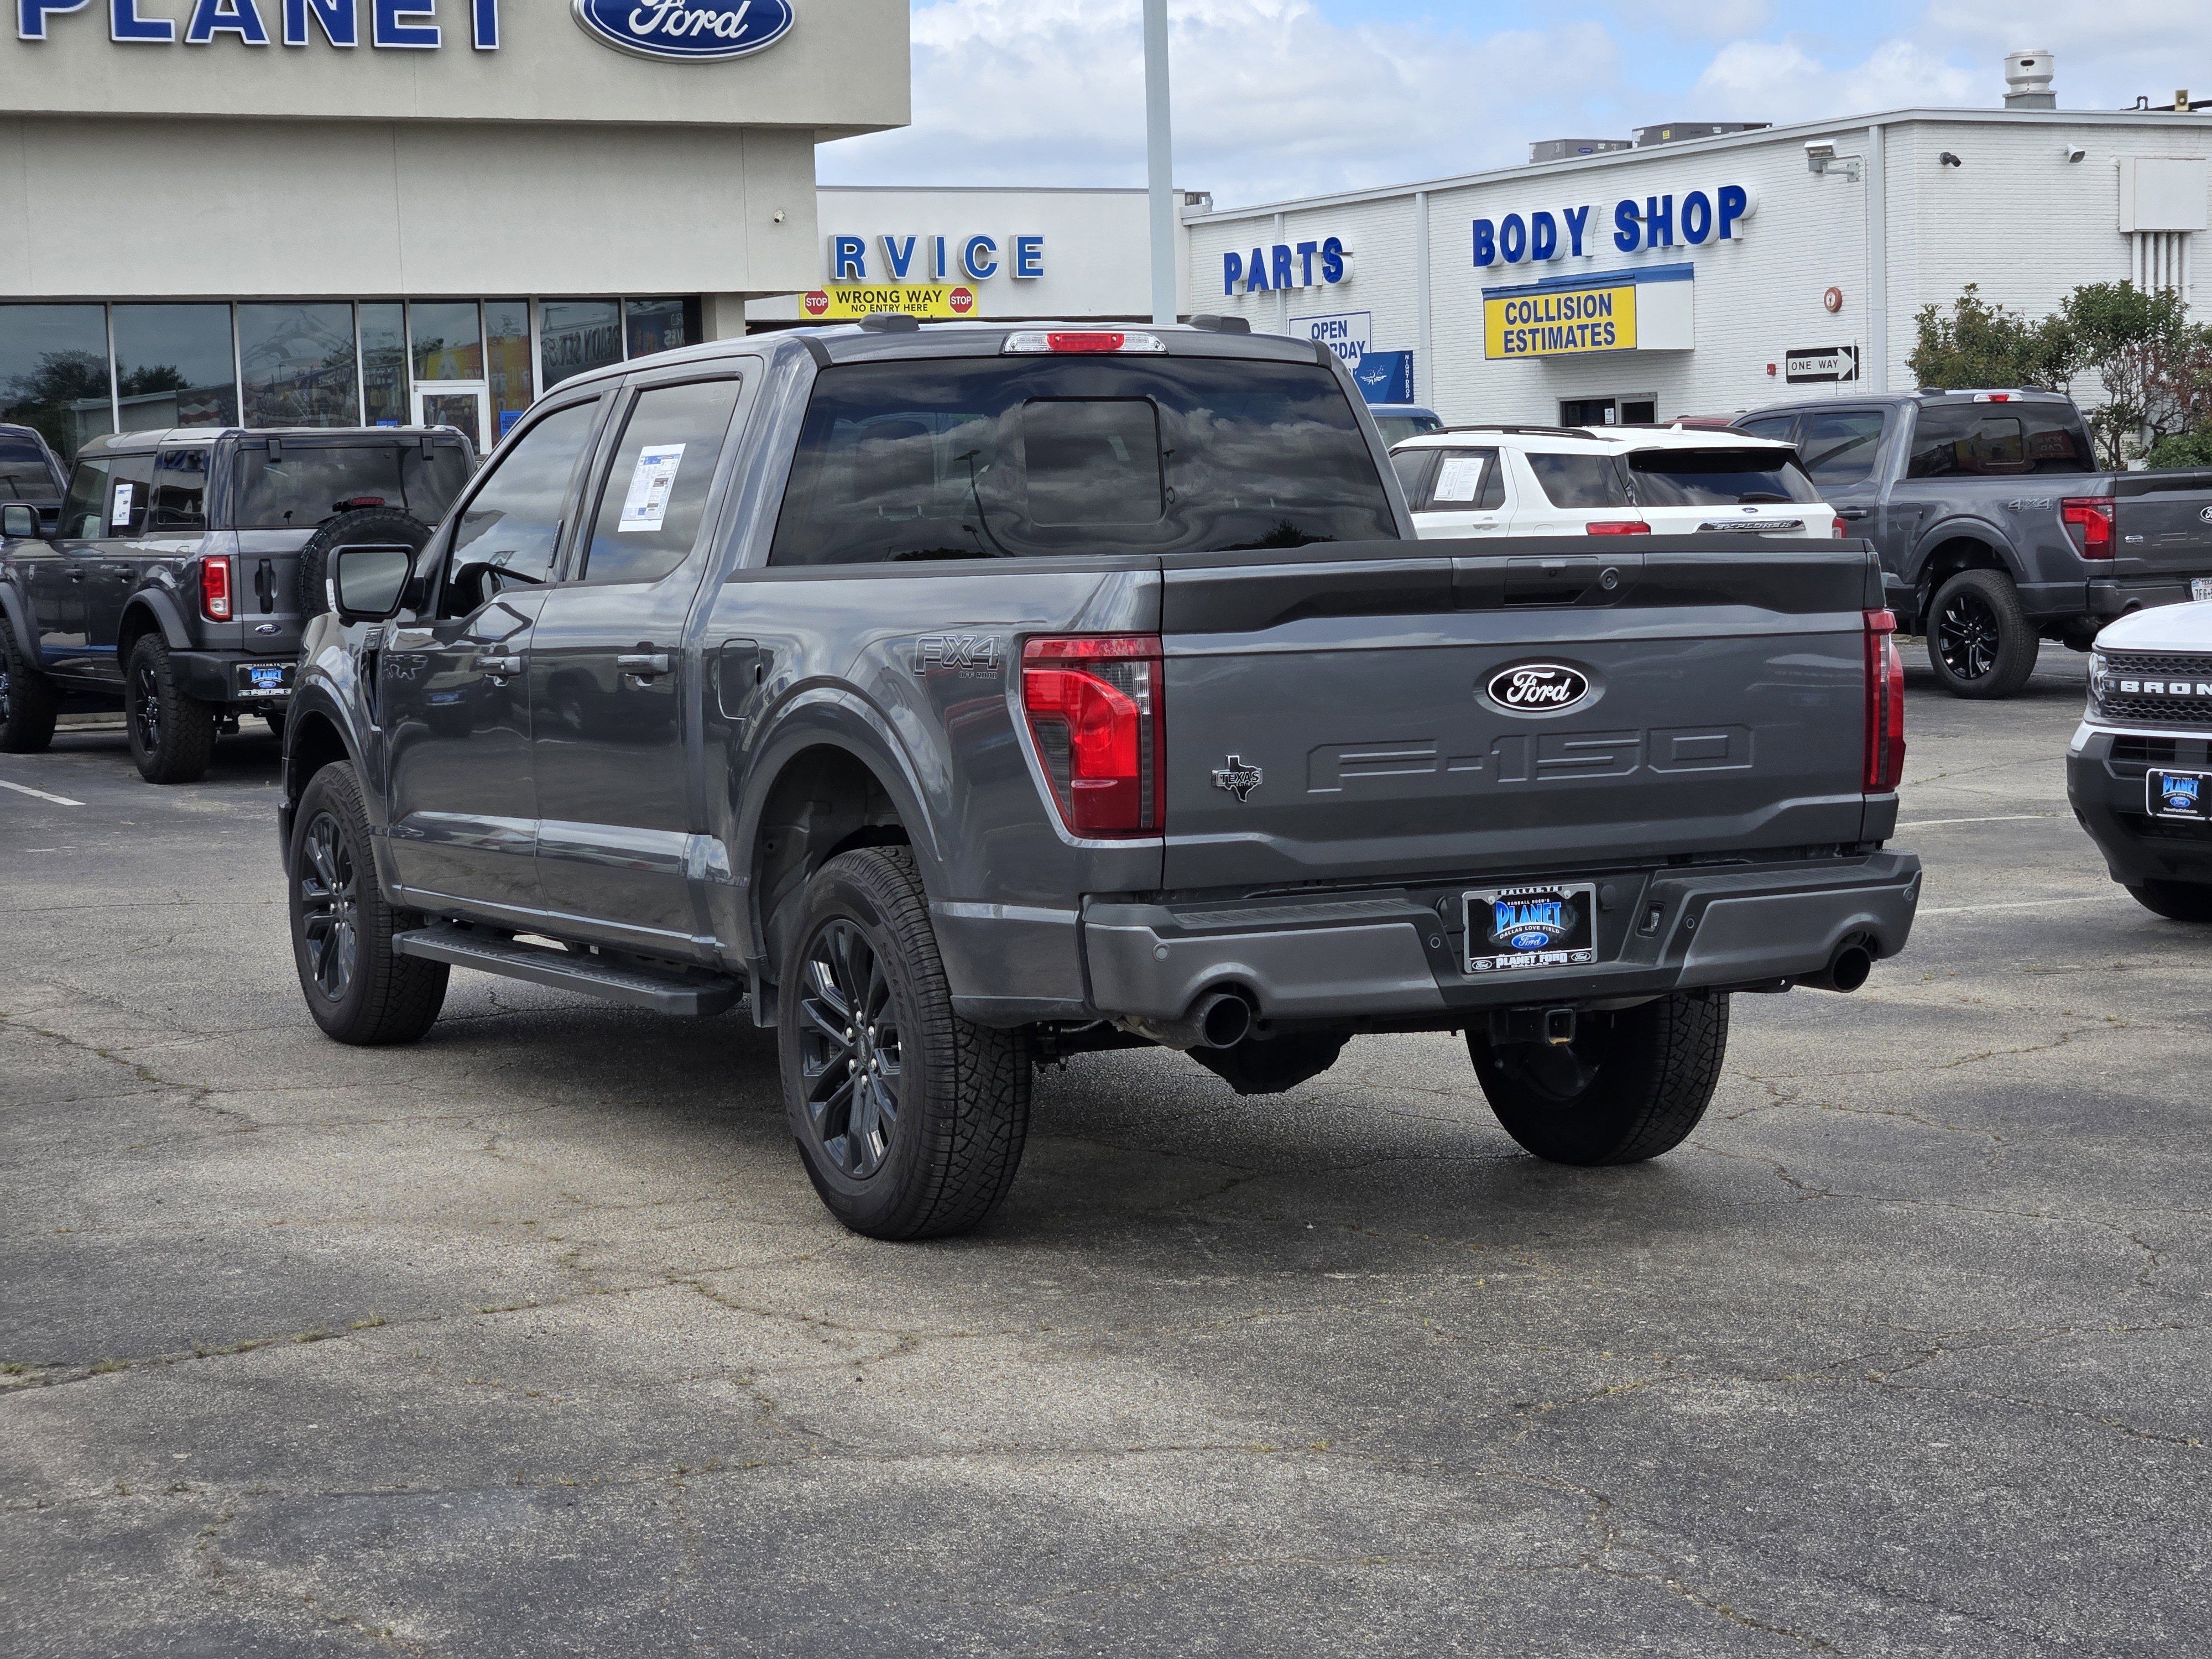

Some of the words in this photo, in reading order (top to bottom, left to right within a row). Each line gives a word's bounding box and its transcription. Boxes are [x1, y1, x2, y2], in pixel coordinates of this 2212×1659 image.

[628, 0, 749, 39] Ford
[1472, 205, 1593, 268] BODY
[1613, 185, 1752, 253] SHOP
[1223, 236, 1347, 296] PARTS
[805, 296, 828, 307] STOP
[836, 291, 900, 304] WRONG
[907, 290, 943, 304] WAY
[950, 295, 972, 306] STOP
[851, 304, 867, 313] NO
[869, 304, 901, 313] ENTRY
[903, 304, 928, 312] HERE
[1505, 292, 1612, 326] COLLISION
[1311, 320, 1348, 340] OPEN
[1503, 321, 1615, 354] ESTIMATES
[1791, 359, 1812, 371] ONE
[1818, 358, 1839, 369] WAY
[913, 634, 1001, 677] FX4
[1506, 670, 1571, 703] Ford
[1306, 722, 1754, 793] F-150
[1220, 772, 1260, 784] TEXAS
[2163, 775, 2199, 796] PLANET
[1496, 900, 1562, 933] PLANET
[1500, 927, 1523, 939] DALLAS
[1542, 926, 1560, 935] FIELD
[1518, 935, 1541, 947] Ford
[1496, 955, 1537, 969] PLANET
[1539, 953, 1568, 963] FORD
